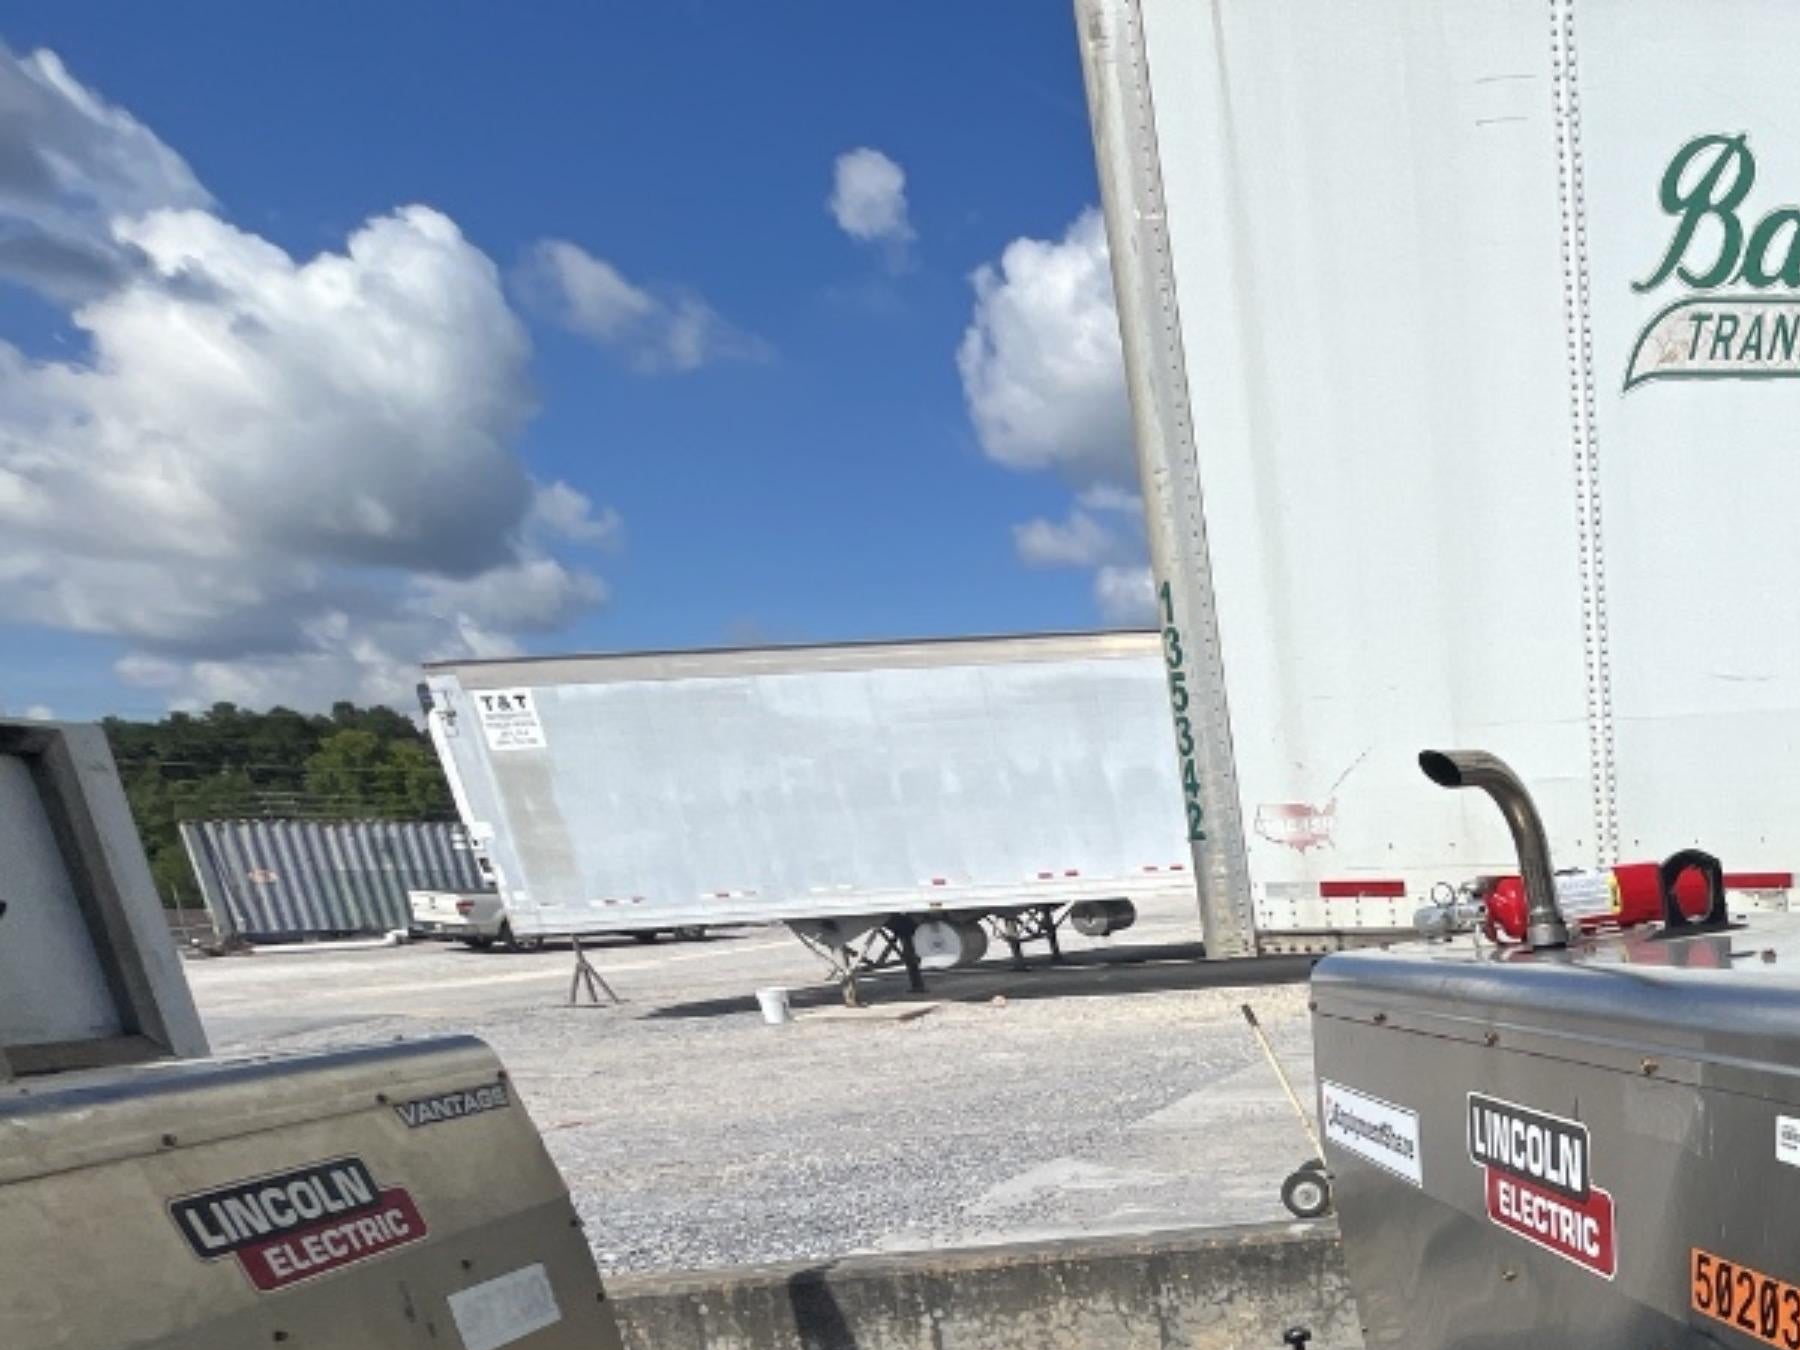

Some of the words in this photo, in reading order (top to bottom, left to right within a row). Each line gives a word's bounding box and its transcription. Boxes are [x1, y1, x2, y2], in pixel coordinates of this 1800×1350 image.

[1159, 579, 1207, 842] 135342
[394, 1086, 507, 1125] VANTAGE
[1472, 1106, 1583, 1193] LINCOLN
[185, 1164, 375, 1249] LINCOLN
[261, 1209, 410, 1281] ELECTRIC
[1498, 1179, 1600, 1259] ELECTRIC
